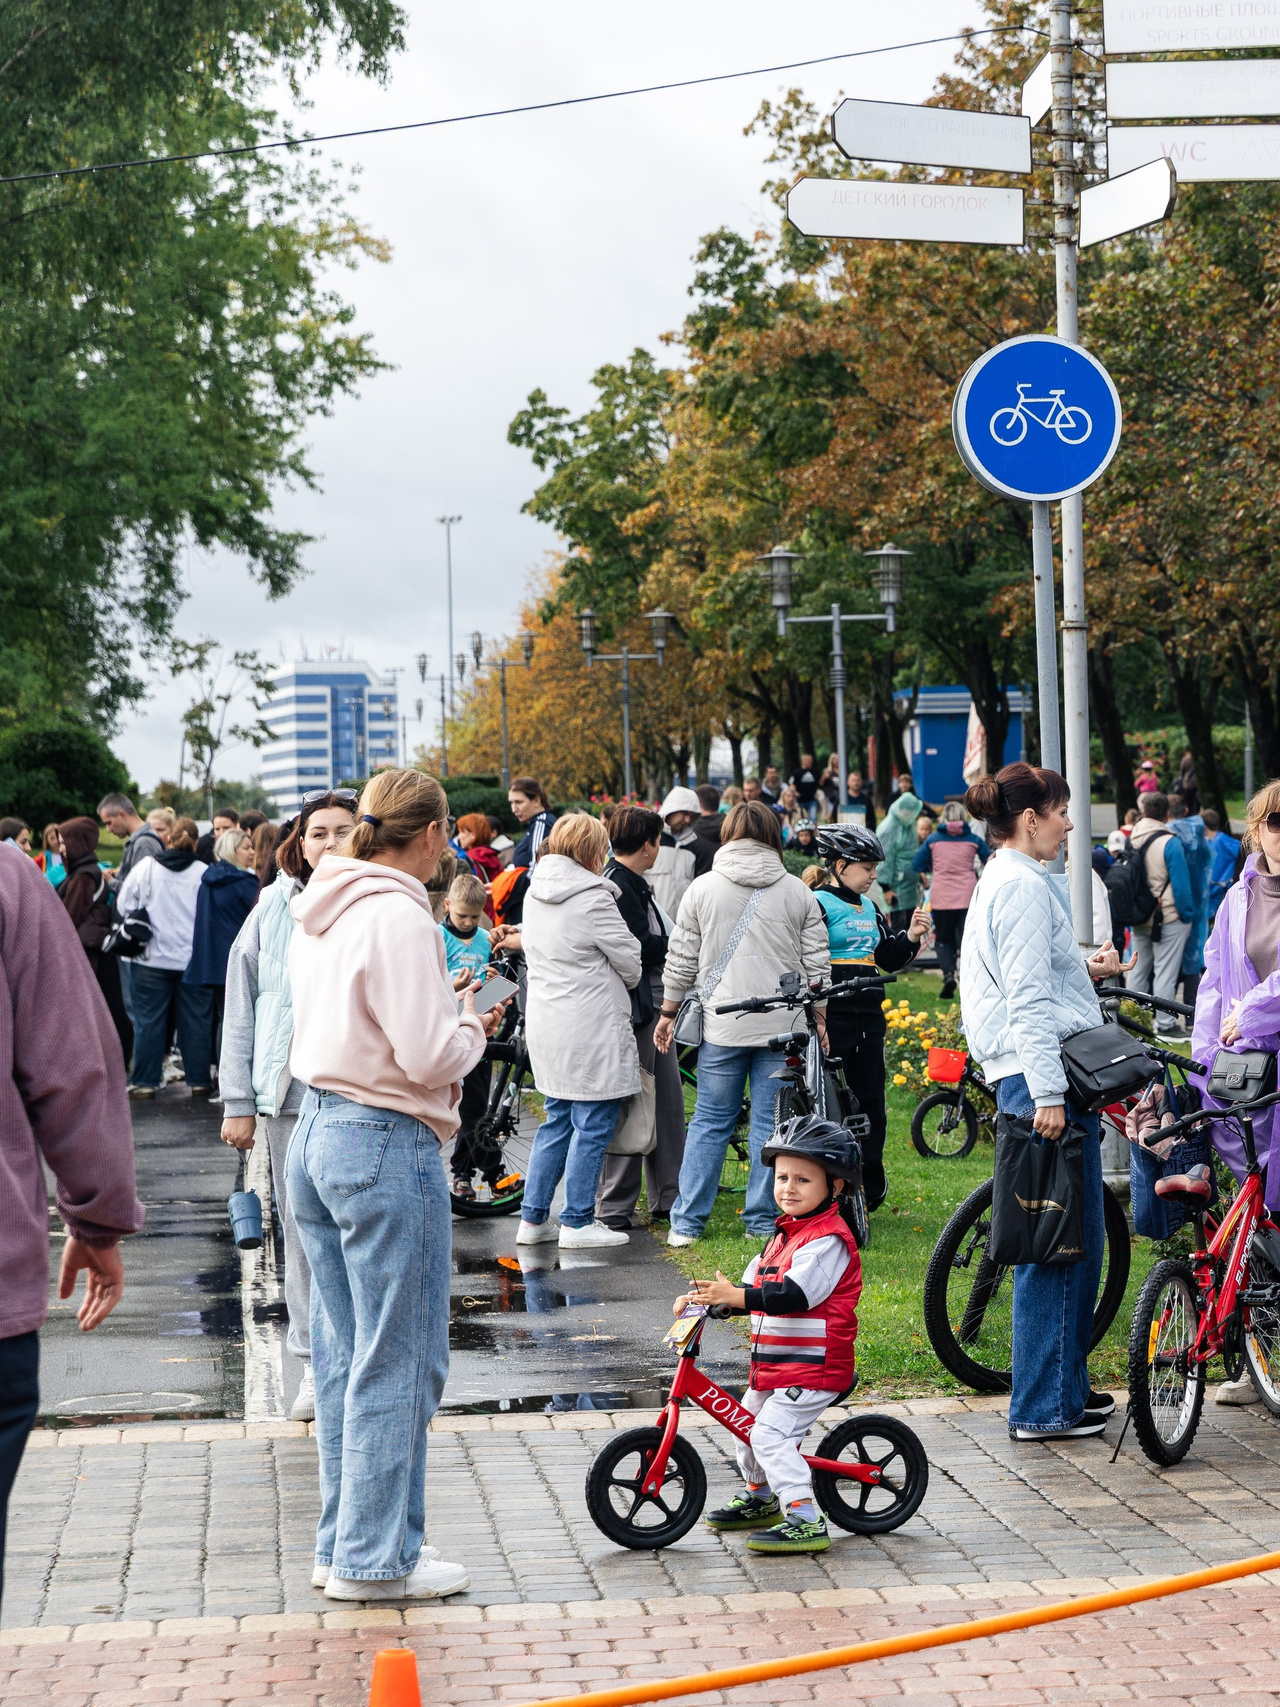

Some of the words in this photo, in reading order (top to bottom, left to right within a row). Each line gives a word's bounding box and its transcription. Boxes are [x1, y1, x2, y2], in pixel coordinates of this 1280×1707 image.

[1111, 3, 1224, 21] ПОРТИВНЫЕ
[1147, 28, 1211, 44] SPORTS
[1160, 140, 1208, 162] WC
[831, 188, 907, 208] ДЕТСКИЙ
[912, 194, 989, 213] ГОРОДОК
[1235, 1215, 1258, 1286] EUROBIKE
